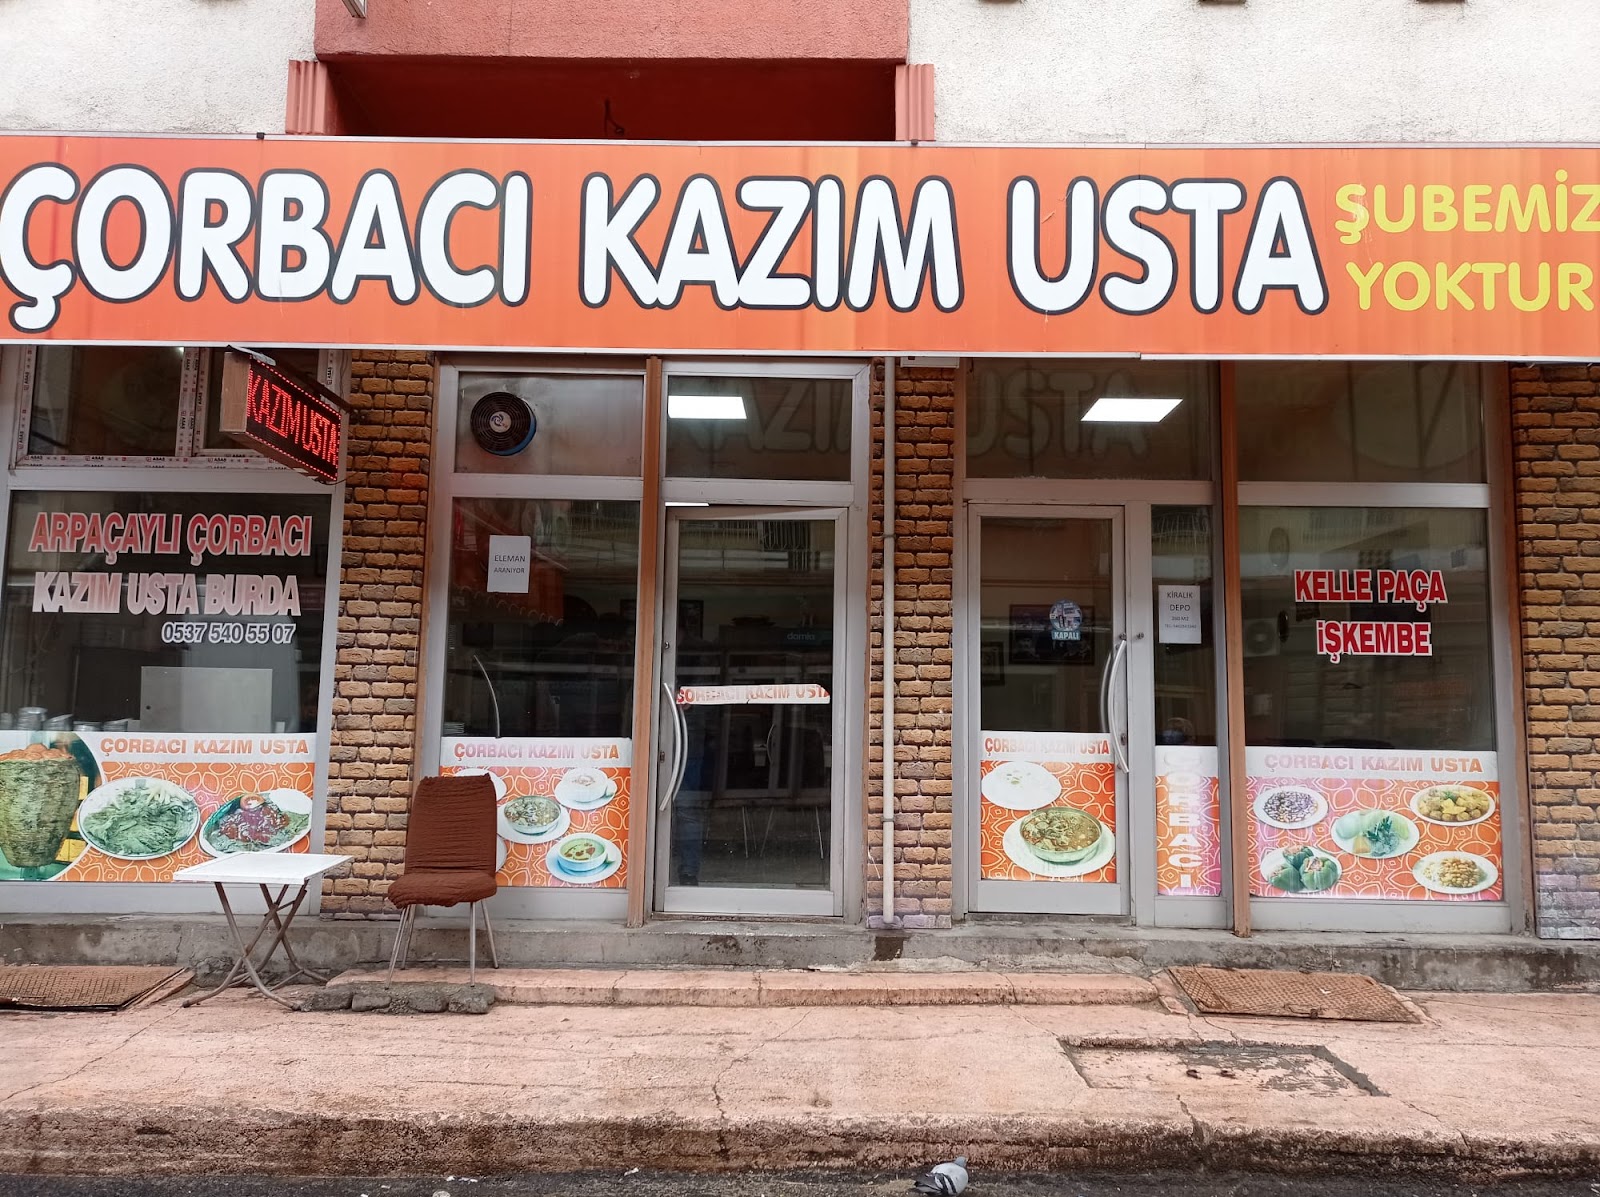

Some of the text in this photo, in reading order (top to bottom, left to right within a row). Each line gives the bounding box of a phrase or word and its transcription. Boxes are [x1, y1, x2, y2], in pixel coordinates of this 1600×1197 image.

[1335, 169, 1600, 245] ŞUBEMİZ
[0, 162, 1329, 334] ÇORBACI KAZIM USTA
[1345, 260, 1595, 312] YOKTUR
[246, 369, 338, 466] KAZIM USTA
[28, 512, 312, 566] ARPAÇAYLI ÇORBACI
[494, 554, 526, 562] ELEMAN
[32, 571, 301, 616] KAZIM USTA BURDA
[1166, 591, 1193, 599] KİRALIK
[1294, 569, 1448, 612] KELLE PAÇA
[1169, 604, 1191, 612] DEPO
[161, 621, 296, 644] 0537 540 55 07
[1054, 631, 1079, 640] KAPALI
[1316, 619, 1433, 664] İŞKEMBE
[100, 738, 309, 757] ÇORBACI KAZIM USTA
[454, 743, 619, 761] ÇORBACI KAZIM USTA
[1080, 740, 1110, 755] USTA
[1264, 754, 1483, 773] ÇORBACI KAZIM USTA
